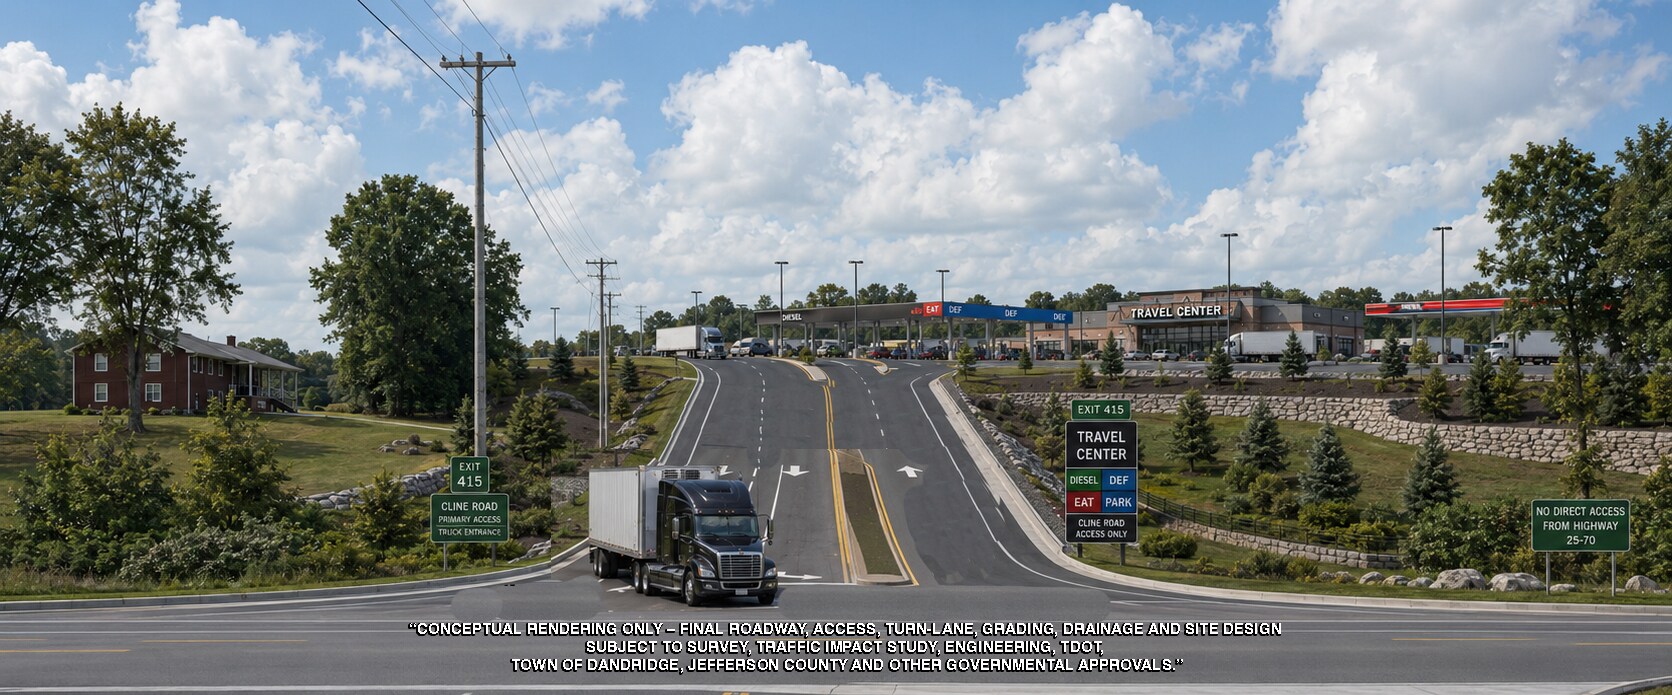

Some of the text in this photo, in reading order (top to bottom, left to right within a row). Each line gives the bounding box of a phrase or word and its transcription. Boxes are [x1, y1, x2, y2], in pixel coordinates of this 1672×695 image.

[926, 305, 939, 314] EAT
[949, 305, 962, 314] DEF
[1005, 309, 1018, 317] DEF
[1131, 305, 1222, 318] TRAVEL CENTER
[782, 313, 802, 321] DIESEL
[1078, 405, 1124, 414] EXIT 415
[1077, 431, 1126, 443] TRAVEL
[1076, 448, 1127, 460] CENTER
[459, 462, 481, 471] EXIT
[457, 476, 482, 487] 415
[1070, 475, 1099, 485] DIESEL
[1109, 475, 1129, 485] DEF
[441, 502, 498, 511] CLINE ROAD
[1074, 497, 1094, 507] EAT
[1105, 497, 1132, 507] PARK
[1536, 506, 1625, 516] NO DIRECT ACCESS
[1078, 519, 1125, 527] CLINE ROAD
[1543, 521, 1619, 531] FROM HIGHWAY
[464, 528, 501, 536] ENTRANCE
[1075, 530, 1128, 538] ACCESS ONLY
[1566, 535, 1596, 545] 25-70
